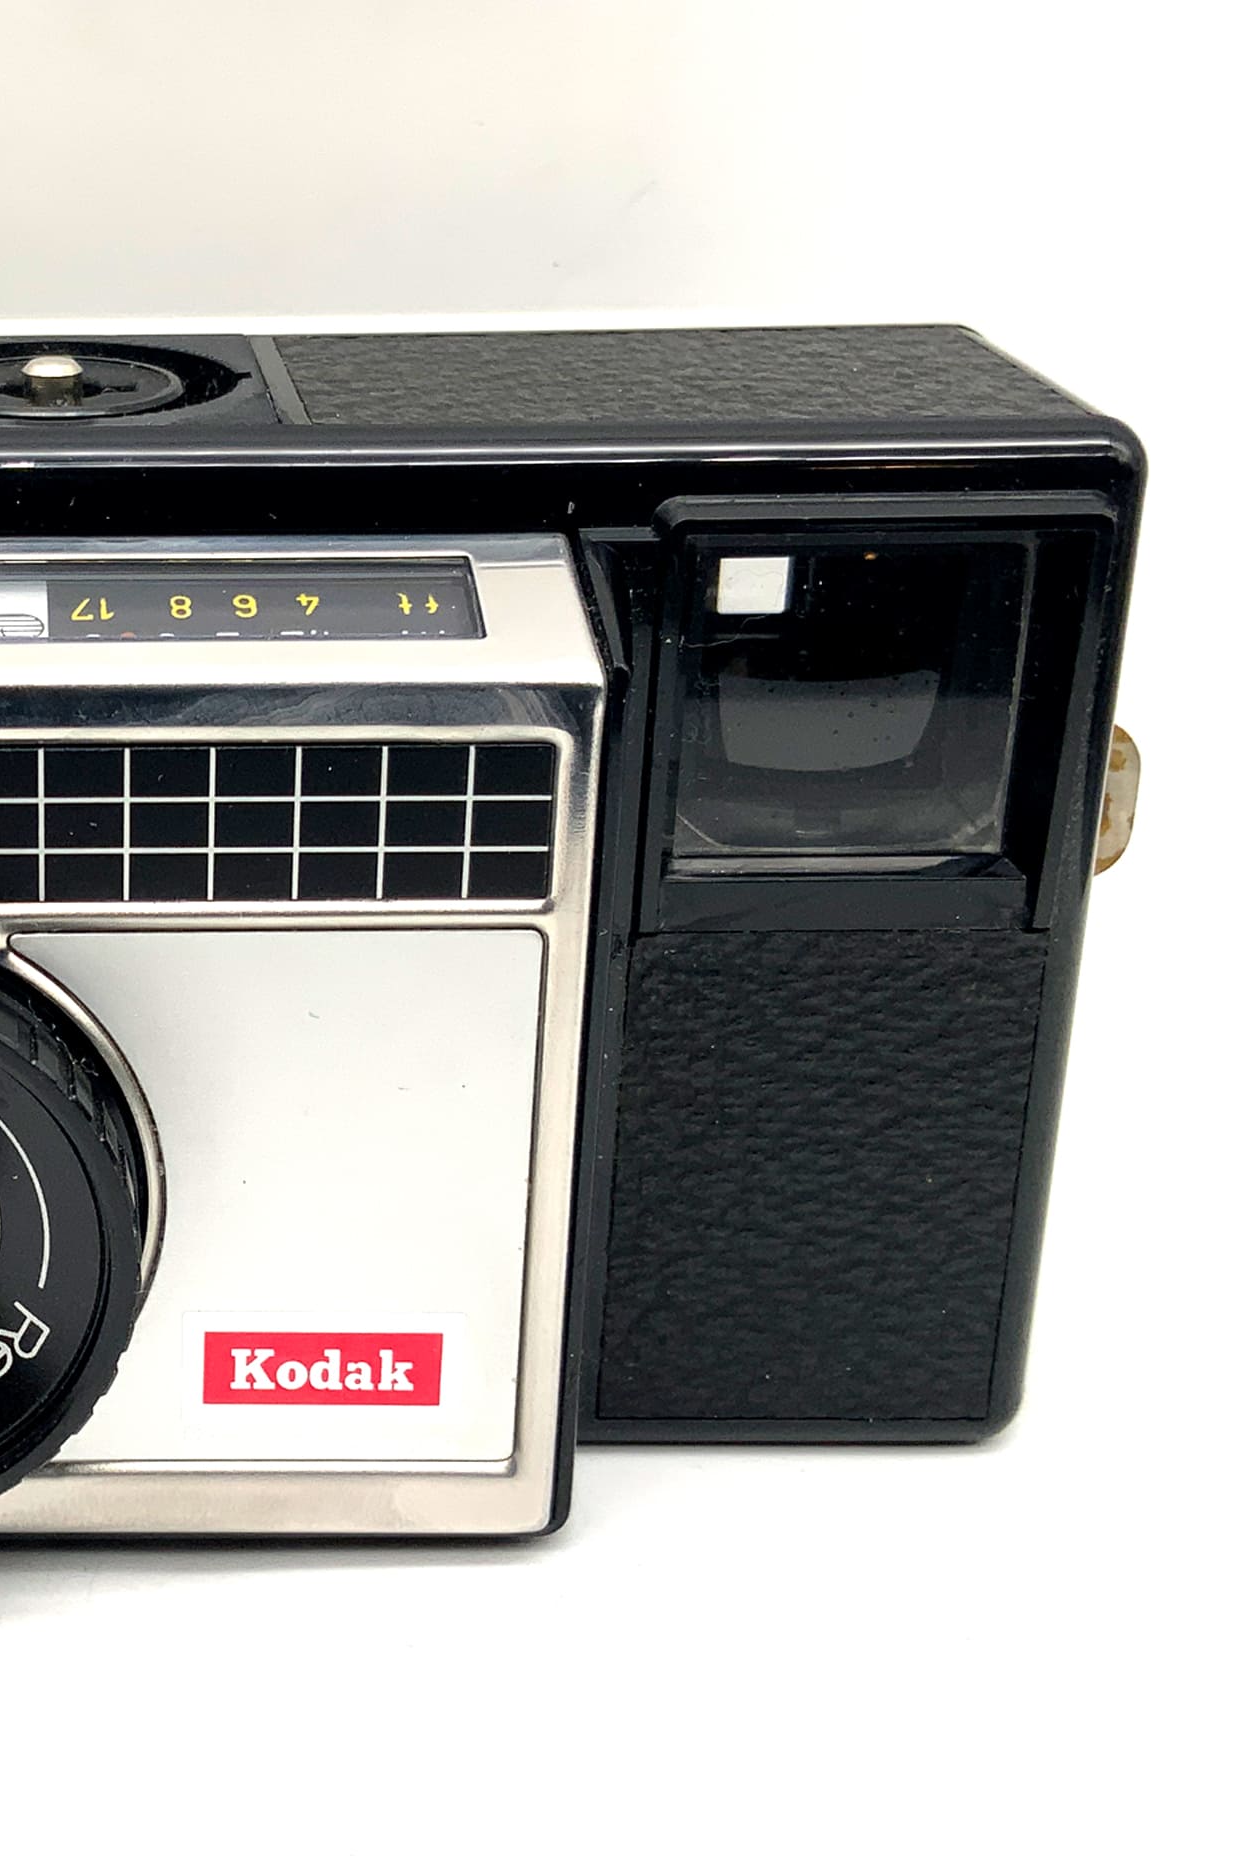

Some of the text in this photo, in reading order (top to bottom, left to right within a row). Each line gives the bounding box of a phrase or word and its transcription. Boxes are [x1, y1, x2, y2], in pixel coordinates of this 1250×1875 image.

[71, 597, 114, 621] 17
[170, 595, 192, 619] 8
[232, 594, 258, 618] 6
[296, 593, 319, 616] 4
[229, 1348, 414, 1391] Kodak
